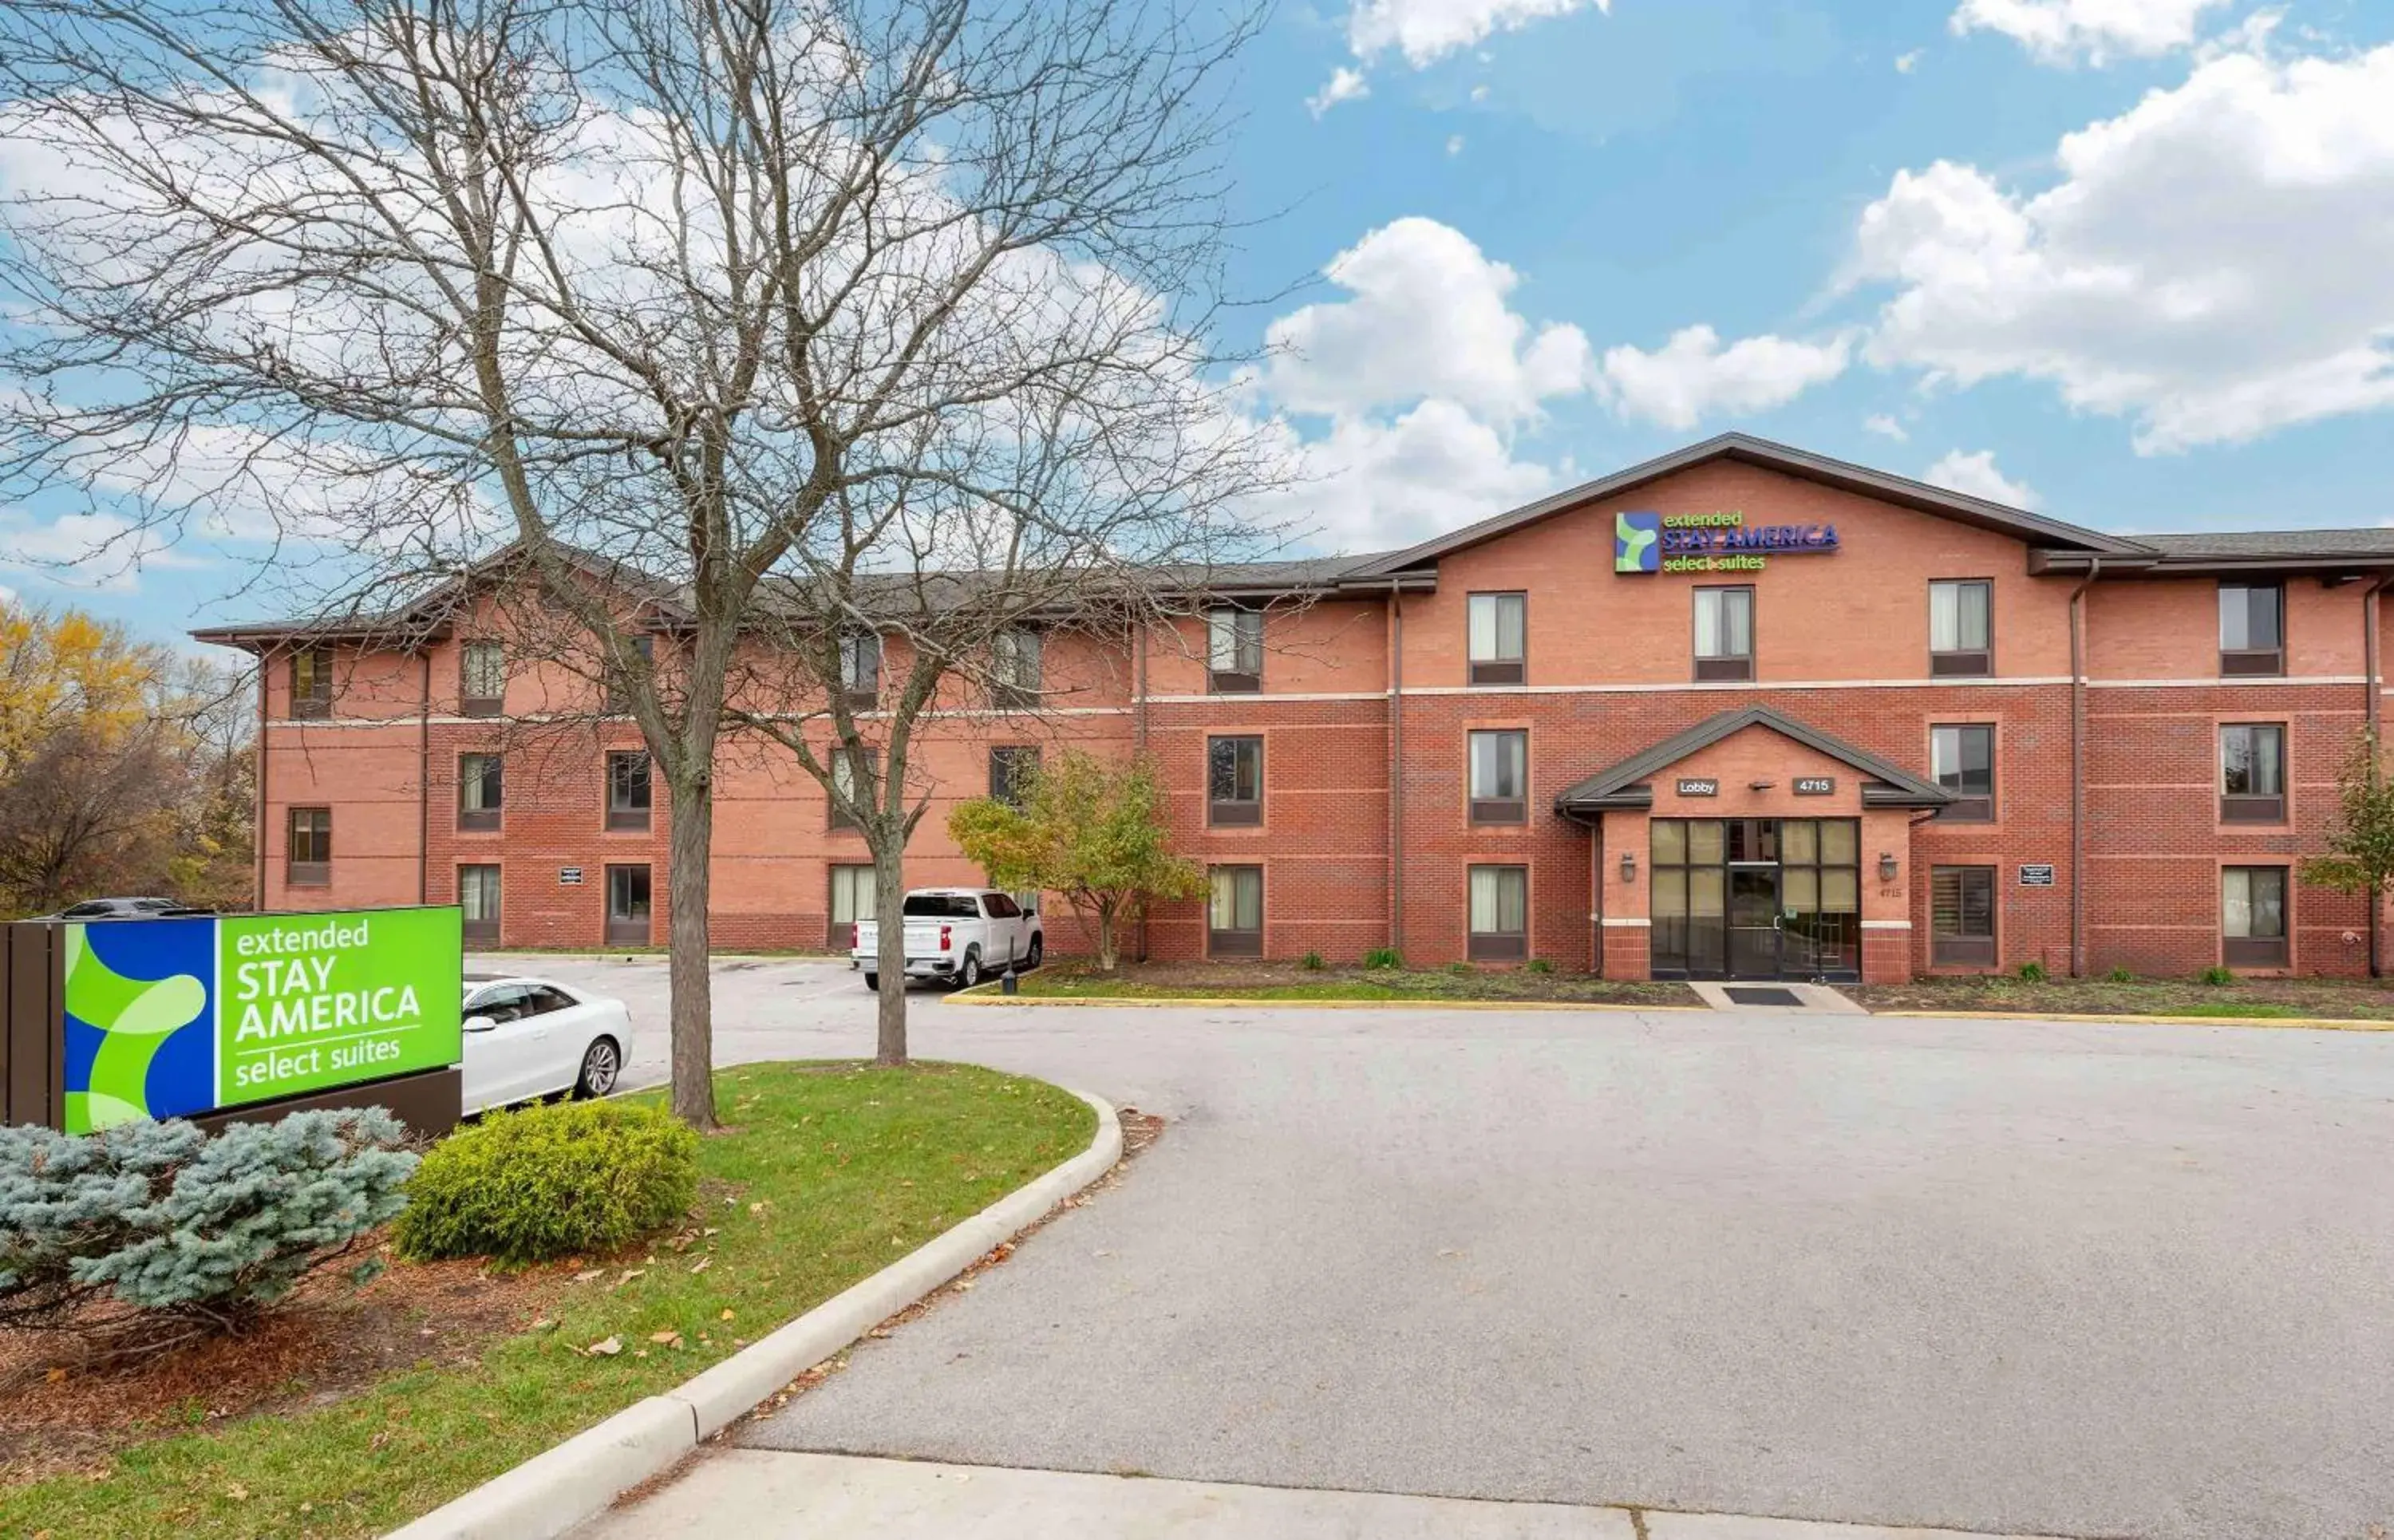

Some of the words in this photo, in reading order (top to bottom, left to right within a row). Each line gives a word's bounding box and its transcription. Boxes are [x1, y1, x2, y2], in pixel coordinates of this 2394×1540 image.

[1664, 511, 1742, 527] extended
[1664, 527, 1718, 549] STAY
[1724, 524, 1839, 547] AMERICA
[1664, 555, 1713, 571] select
[1717, 554, 1765, 569] suites
[1680, 782, 1715, 795] Lobby
[1799, 780, 1829, 791] 4715
[237, 919, 368, 955] extended
[237, 956, 336, 1000] STAY
[235, 985, 421, 1042] AMERICA
[235, 1049, 321, 1087] select
[331, 1040, 400, 1070] suites
